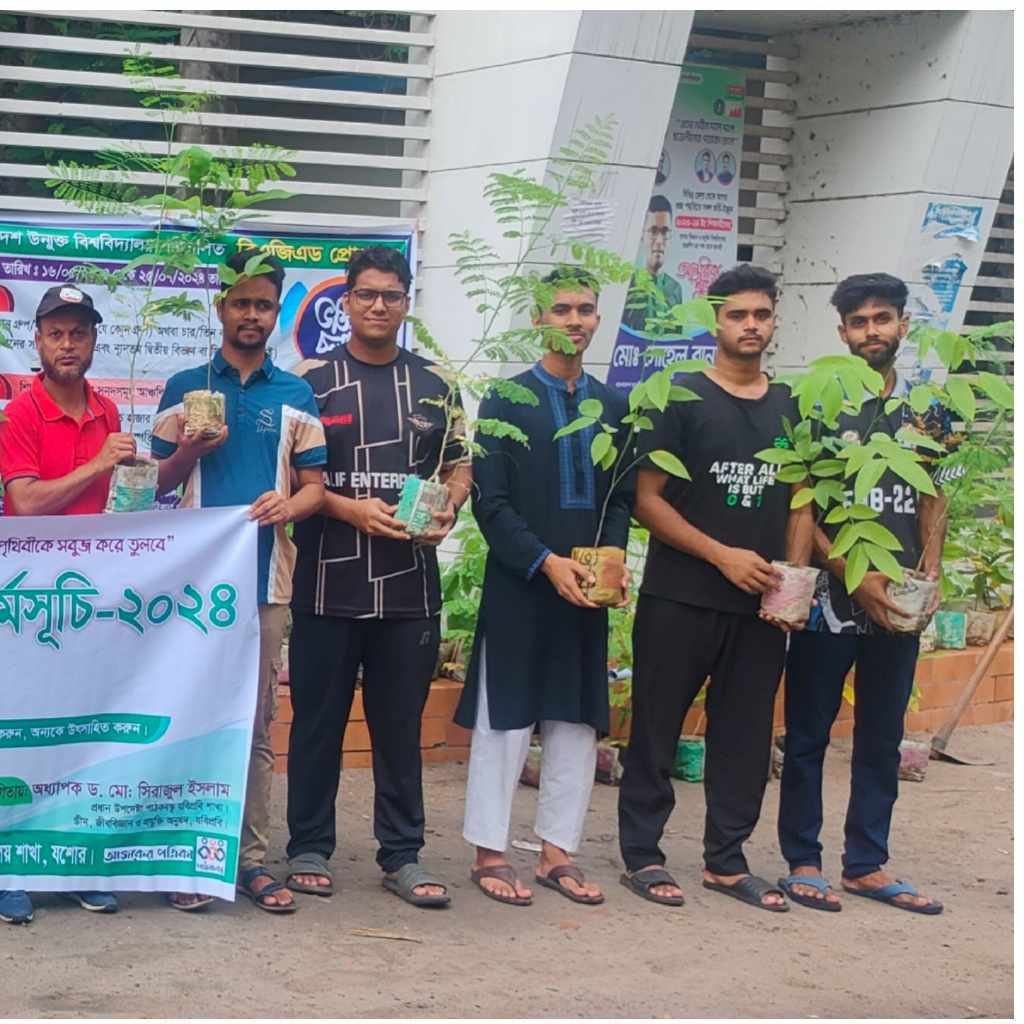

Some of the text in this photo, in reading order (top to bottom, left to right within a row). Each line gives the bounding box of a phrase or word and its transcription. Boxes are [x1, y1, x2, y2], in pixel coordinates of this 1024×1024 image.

[26, 230, 69, 252] উন্মুক্ত
[2, 260, 32, 276] তারিখ
[709, 461, 755, 476] AFTER
[716, 473, 775, 486] WHAT LIFE
[727, 483, 764, 496] IS BUT
[740, 495, 752, 508] &
[57, 538, 91, 557] সবুজ
[95, 538, 124, 553] করে
[32, 782, 82, 798] অধ্যাপক
[138, 780, 183, 800] সিরাজুল
[187, 779, 231, 797] ইসলাম
